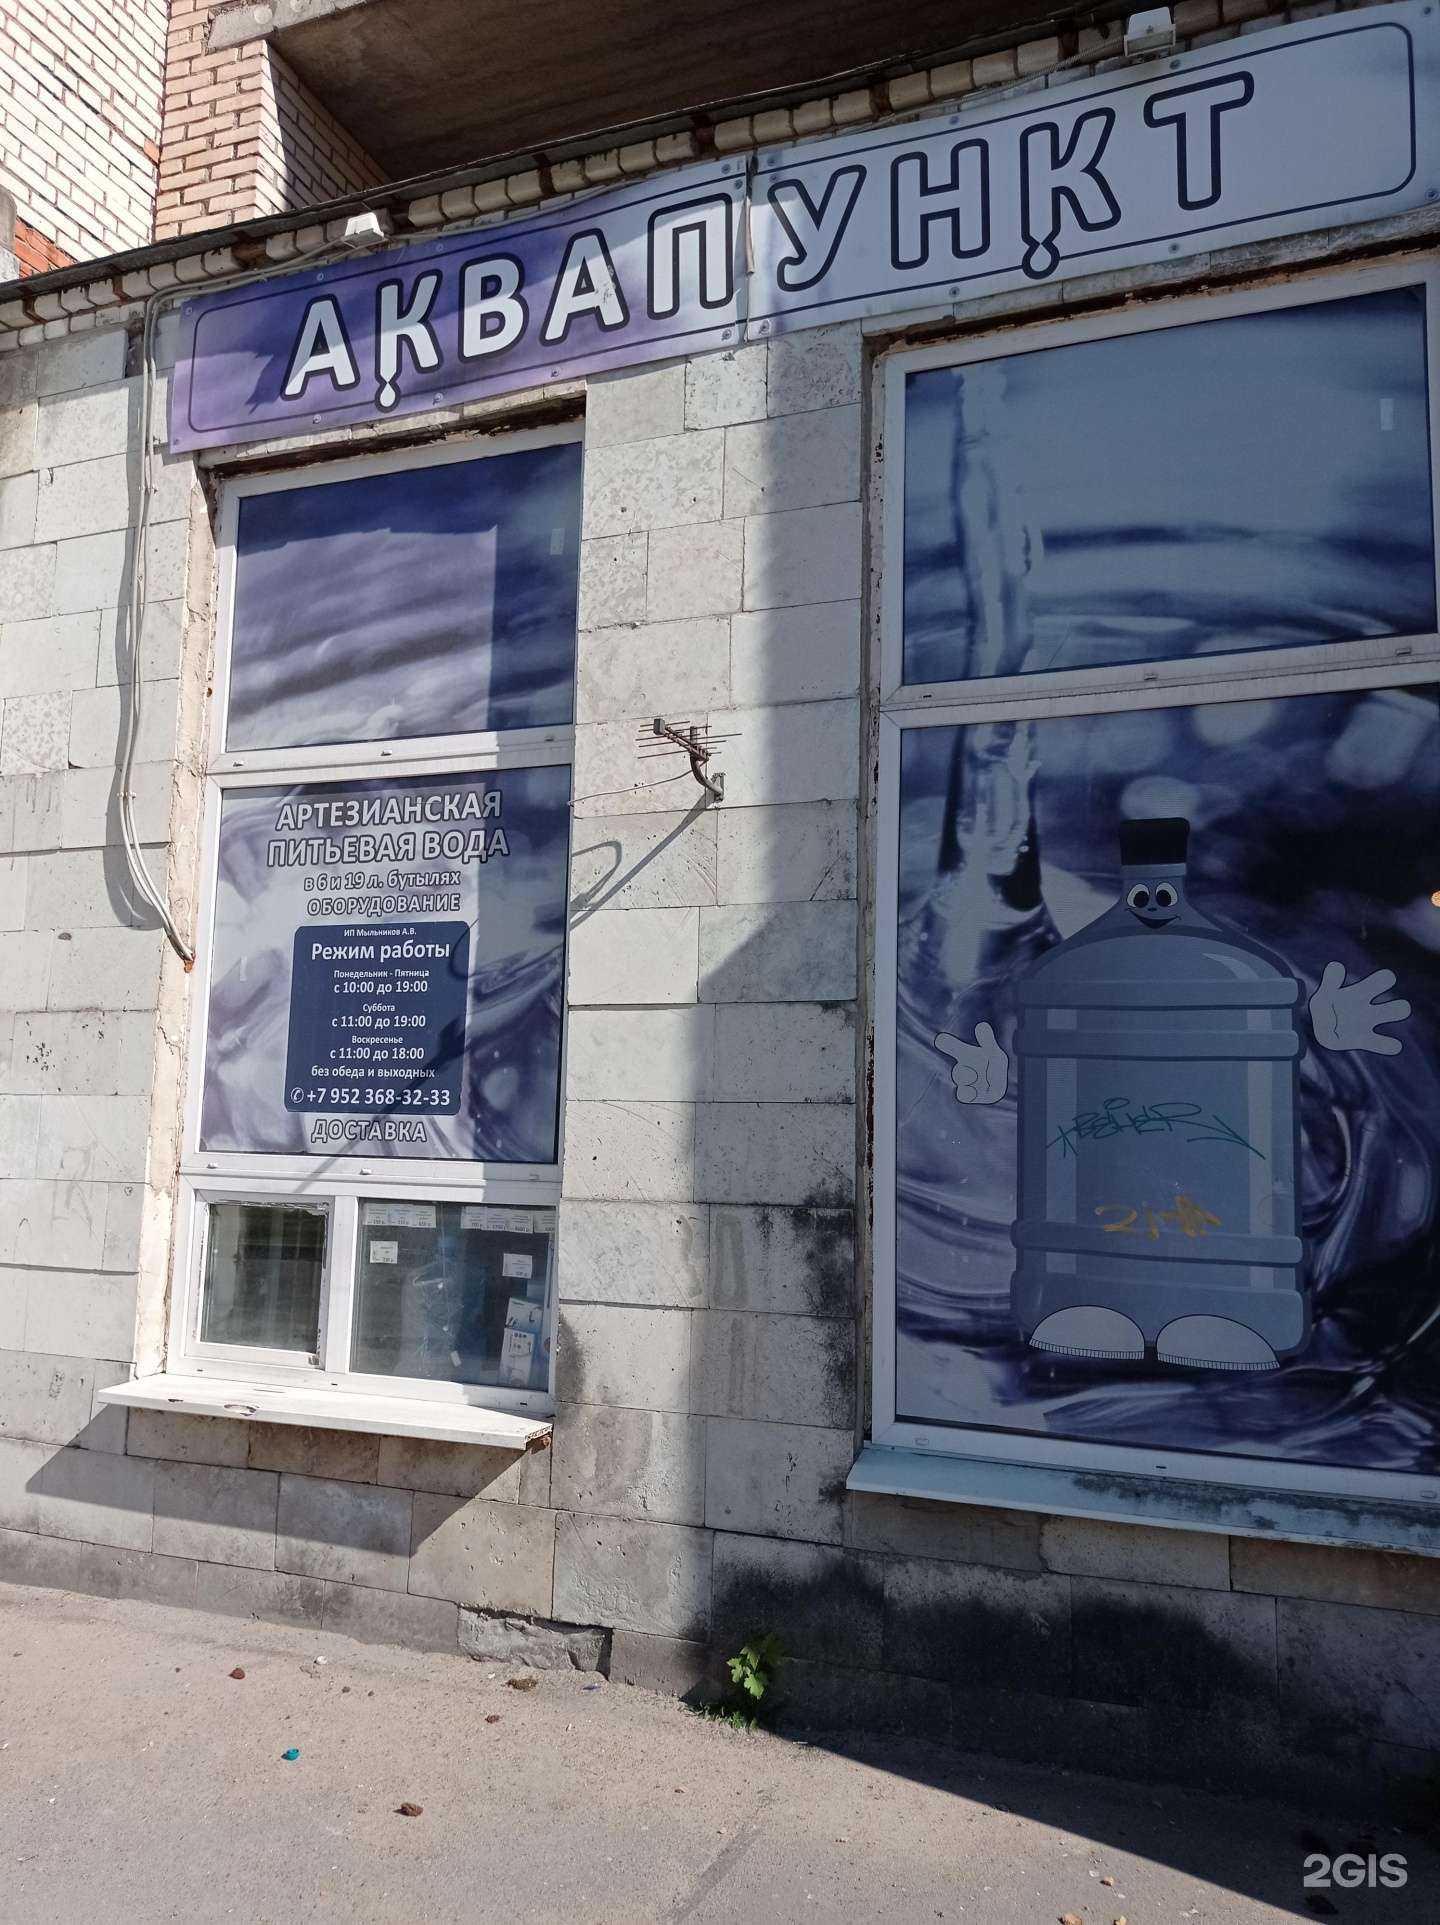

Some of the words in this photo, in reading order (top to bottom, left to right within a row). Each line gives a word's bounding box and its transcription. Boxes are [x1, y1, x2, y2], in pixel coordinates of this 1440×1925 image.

[280, 70, 1256, 409] АКВАПУНКТ
[275, 791, 501, 831] АРТЕЗИАНСКАЯ
[267, 834, 415, 866] ПИТЬЕВАЯ
[423, 829, 510, 864] ВОДА
[303, 876, 314, 891] в
[316, 873, 327, 890] 6
[329, 875, 341, 890] и
[344, 871, 365, 889] 19
[367, 874, 384, 889] л.
[387, 870, 461, 891] бутылях
[307, 893, 461, 917] ОБОРУДОВАНИЕ
[344, 929, 355, 937] ИП
[356, 928, 400, 937] Мыльников
[402, 928, 417, 936] А.В.
[311, 943, 375, 960] Режим
[380, 940, 450, 962] работы
[334, 969, 388, 979] Понедельник
[394, 968, 430, 978] Пятница
[334, 984, 340, 993] с
[343, 981, 374, 993] 10:00
[376, 984, 392, 995] до
[396, 980, 428, 992] 19:00
[362, 1003, 395, 1013] Суббота
[332, 1018, 338, 1027] с
[341, 1016, 372, 1027] 11:00
[374, 1018, 390, 1029] до
[394, 1015, 426, 1027] 19:00
[351, 1036, 403, 1045] Воскресенье
[330, 1050, 336, 1059] с
[339, 1048, 371, 1059] 11:00
[373, 1050, 389, 1061] до
[392, 1047, 425, 1059] 18:00
[311, 1066, 329, 1077] без
[332, 1066, 365, 1078] обеда
[368, 1069, 375, 1077] и
[377, 1069, 435, 1079] выходных
[307, 1088, 326, 1103] +7
[331, 1088, 360, 1104] 952
[365, 1088, 450, 1105] 368-32-33
[311, 1119, 427, 1143] ДОСТАВКА
